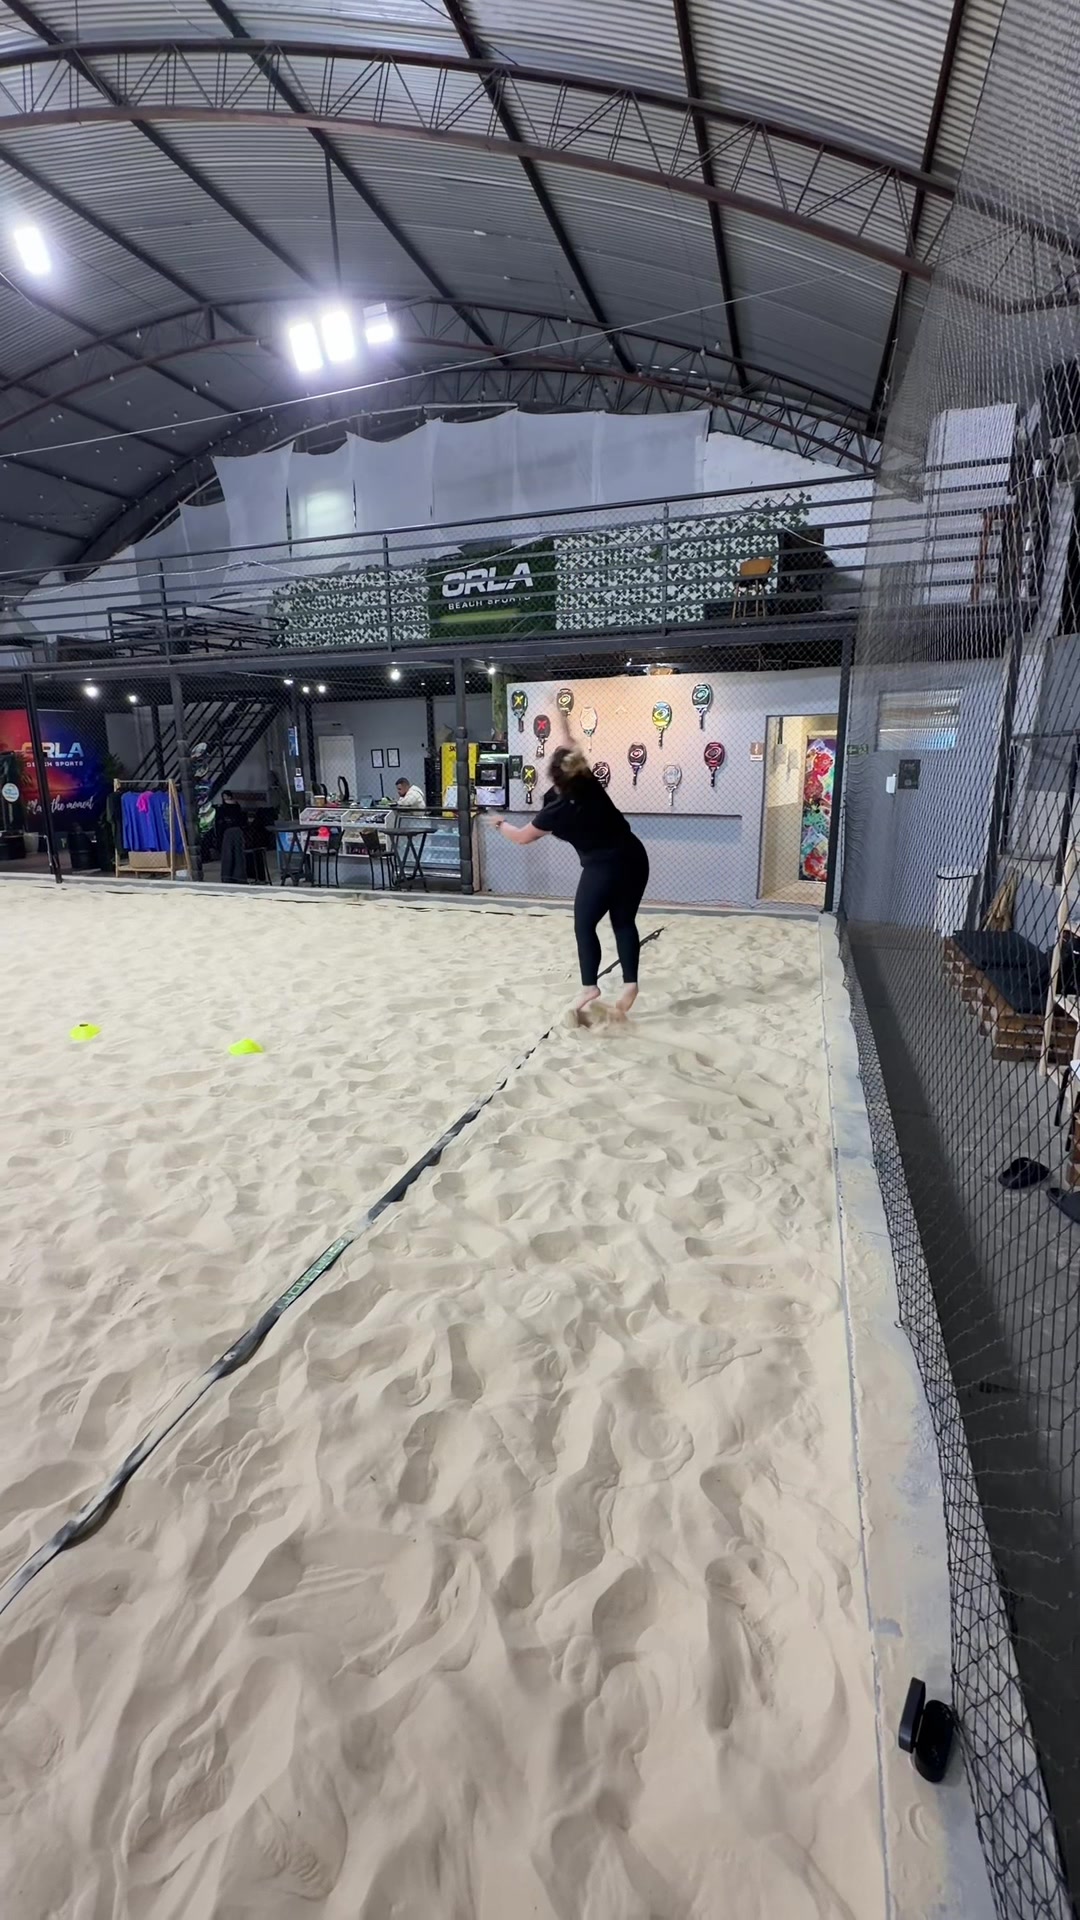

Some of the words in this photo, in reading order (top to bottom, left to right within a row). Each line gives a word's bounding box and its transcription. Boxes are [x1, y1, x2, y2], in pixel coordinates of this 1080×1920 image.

[442, 562, 534, 597] ORLA
[448, 601, 483, 610] BEACH
[50, 795, 65, 813] the
[66, 793, 97, 809] moment
